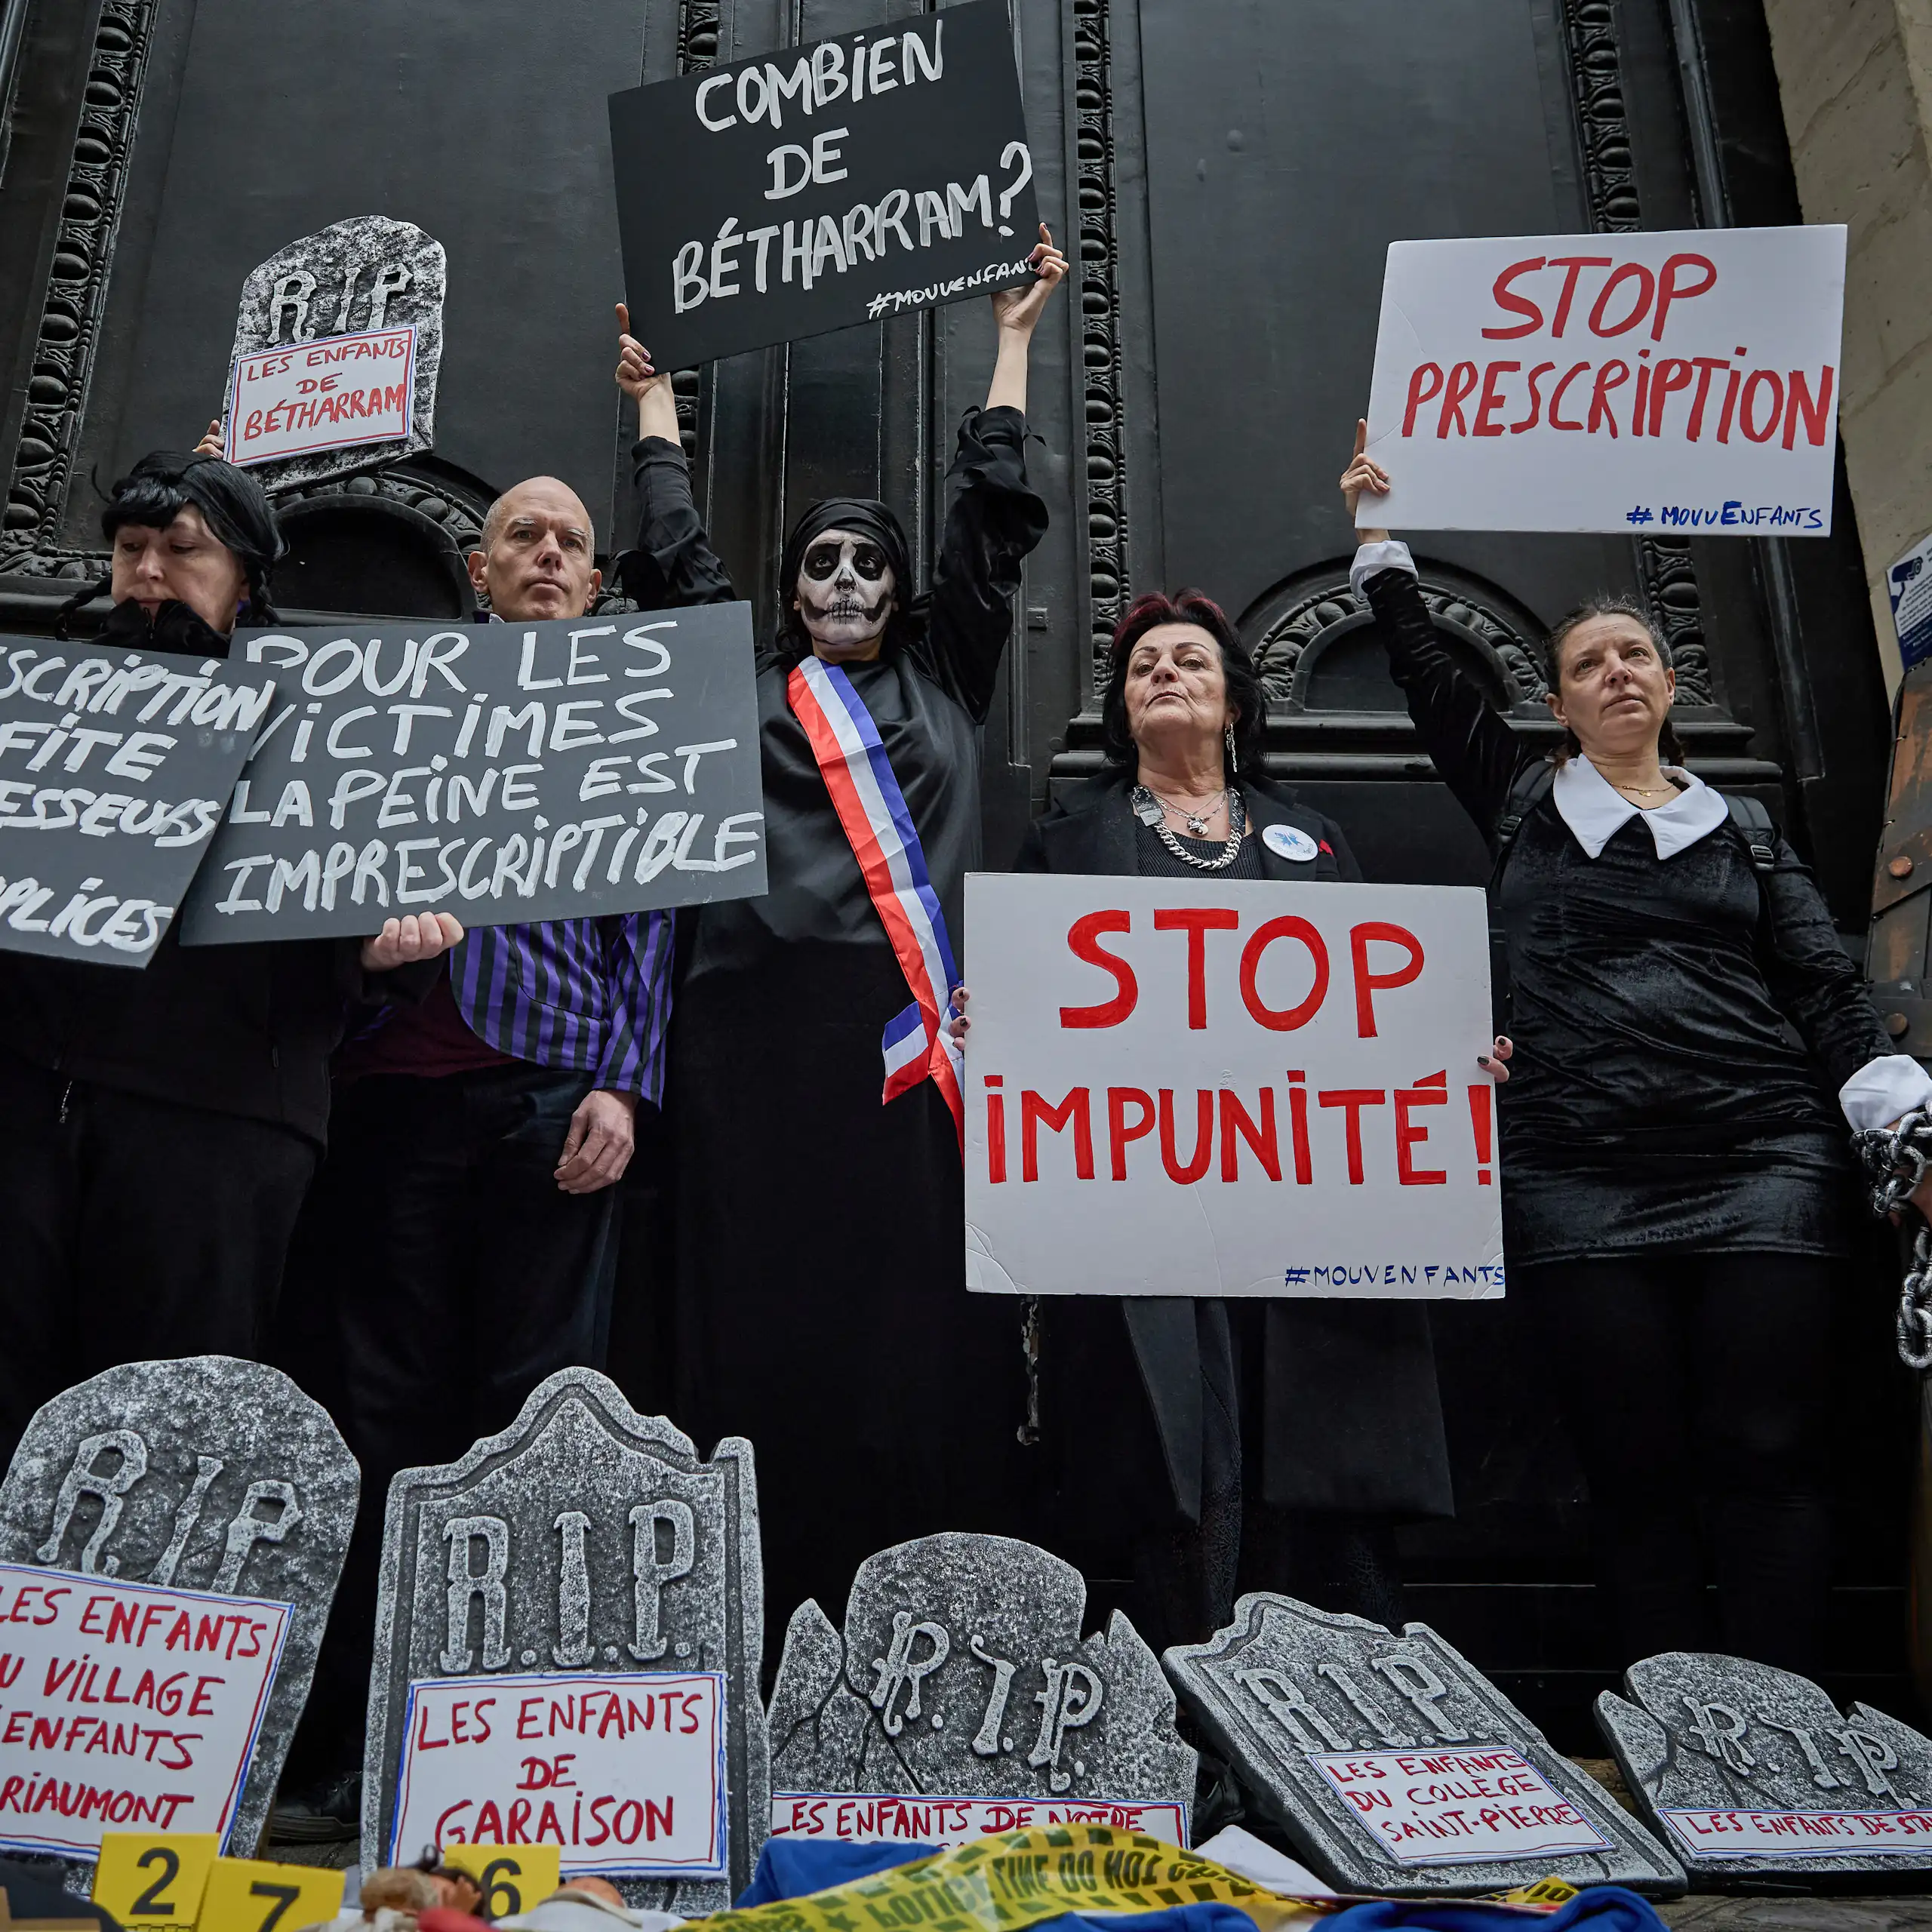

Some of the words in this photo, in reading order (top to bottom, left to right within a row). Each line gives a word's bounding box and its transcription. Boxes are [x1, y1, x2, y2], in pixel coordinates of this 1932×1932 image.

[764, 127, 849, 200] DE
[866, 257, 1037, 320] #MOUVENFAN
[1481, 253, 1717, 342] STOP
[247, 355, 294, 381] LES
[306, 337, 408, 366] ENFANTS
[296, 373, 343, 394] DE
[244, 383, 406, 441] BÉTHARRAM
[0, 645, 277, 732] SCRIPTION
[246, 632, 469, 698] POUR
[517, 620, 678, 691] LES
[229, 780, 313, 827] LA
[579, 738, 738, 802] EST
[0, 876, 174, 953] PLICES
[1059, 908, 1425, 1038] STOP
[79, 1595, 267, 1660] ENFANTS
[43, 1654, 226, 1717] VILLAGE
[418, 1699, 496, 1752] LES
[517, 1690, 703, 1740] ENFANTS
[516, 1754, 576, 1791] DE
[1327, 1761, 1387, 1783] LES
[1395, 1752, 1527, 1776] ENFANTS
[1344, 1789, 1393, 1812] DU
[1406, 1774, 1543, 1805] COLLÈGE
[836, 1798, 972, 1839] ENFANTS
[980, 1806, 1035, 1834] DE
[1685, 1814, 1744, 1835] LES
[1753, 1814, 1855, 1835] ENFANTS
[1857, 1815, 1897, 1835] DE
[1897, 1814, 1932, 1835] STA
[130, 1847, 180, 1915] 2
[250, 1881, 300, 1932] 7
[480, 1857, 522, 1921] 6
